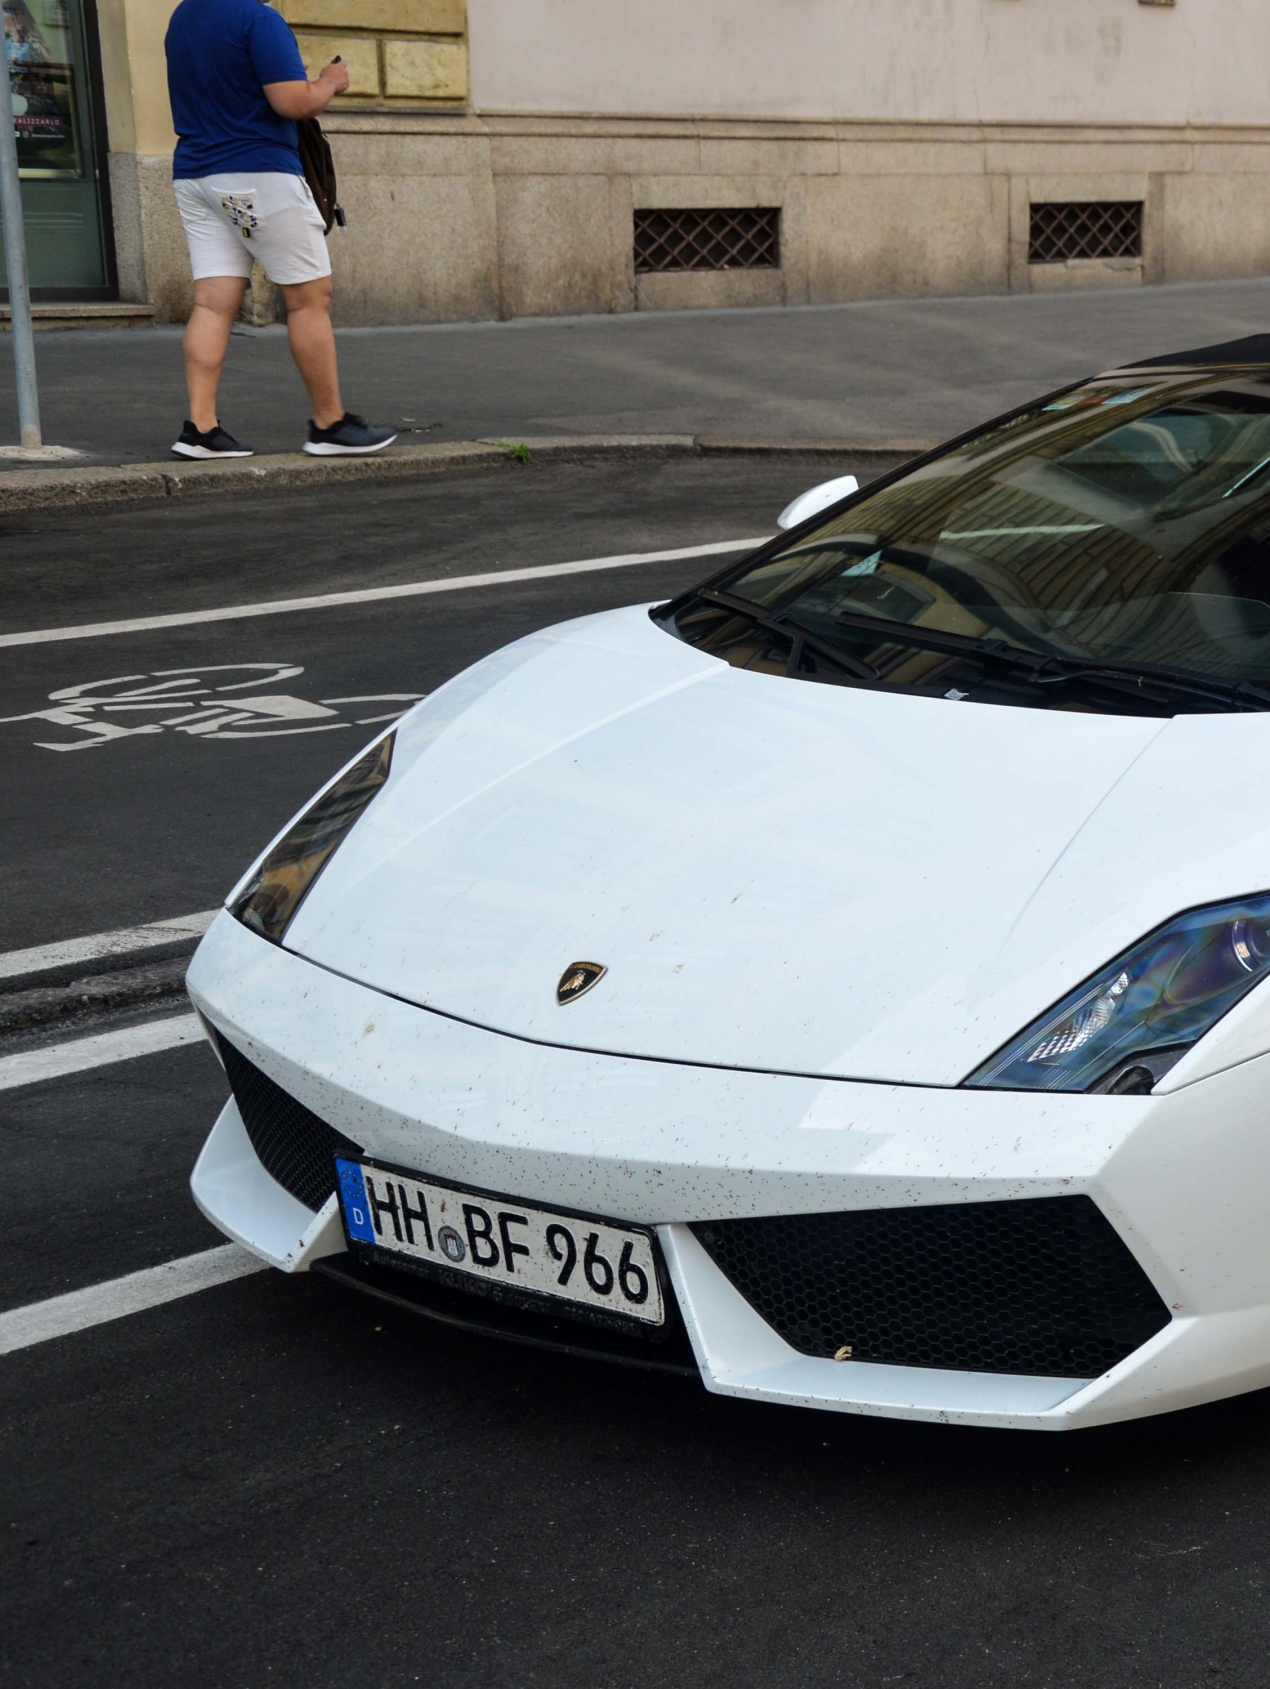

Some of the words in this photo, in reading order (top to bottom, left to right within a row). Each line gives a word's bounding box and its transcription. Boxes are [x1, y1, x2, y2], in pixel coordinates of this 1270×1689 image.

[352, 1207, 364, 1225] D
[366, 1175, 435, 1251] HH
[462, 1203, 530, 1273] BF
[546, 1223, 649, 1305] 966
